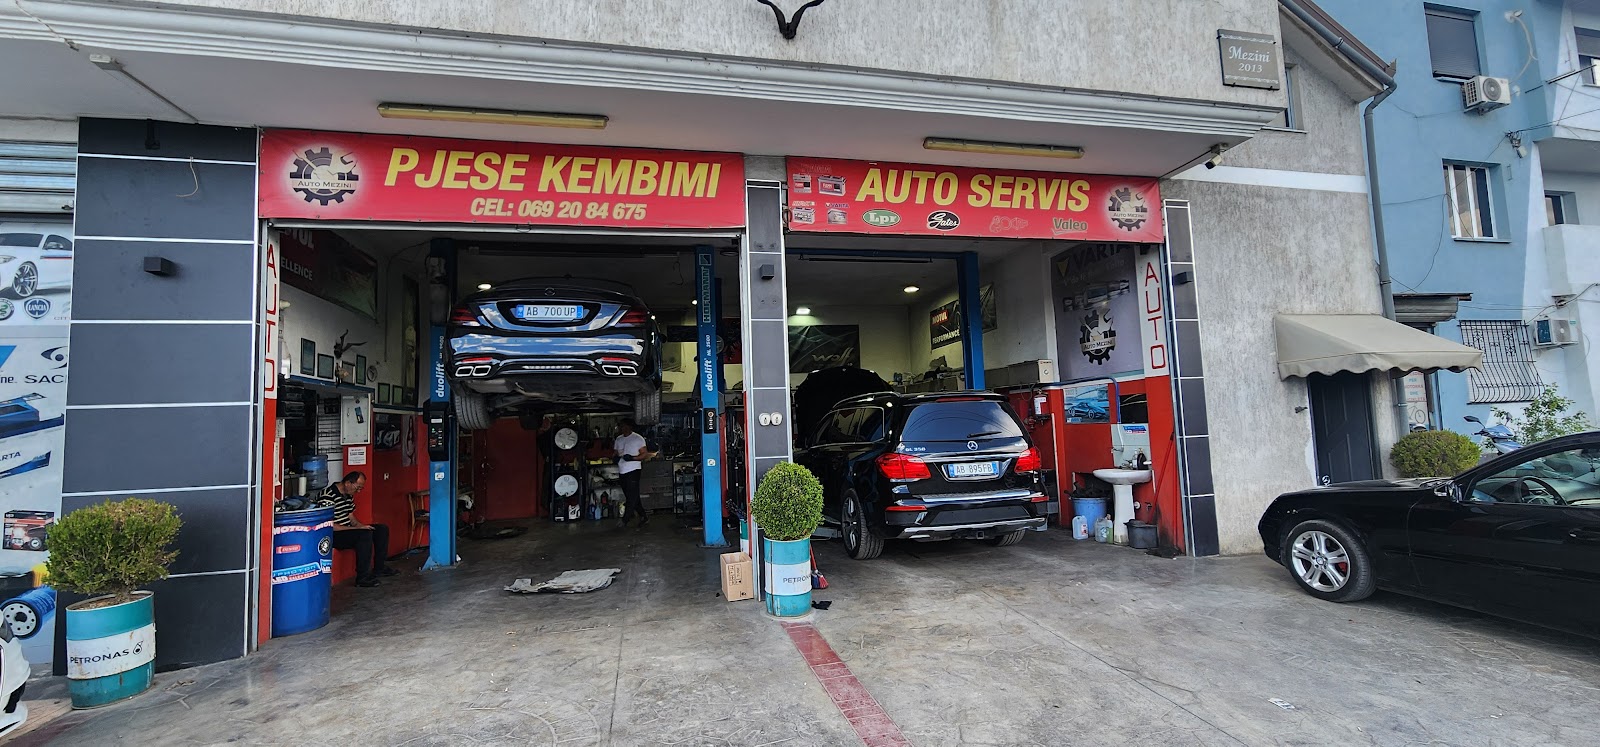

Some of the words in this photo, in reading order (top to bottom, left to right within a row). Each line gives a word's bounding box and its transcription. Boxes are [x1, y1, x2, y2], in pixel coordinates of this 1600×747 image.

[1228, 46, 1270, 63] Mezini
[1238, 63, 1263, 73] 2013
[384, 147, 530, 191] PJESE
[537, 155, 722, 198] KEMBIMI
[322, 181, 352, 189] MEZINI
[855, 168, 959, 206] AUTO
[967, 174, 1091, 213] SERVIS
[470, 197, 514, 217] CEL:
[518, 199, 555, 218] 069
[557, 201, 582, 219] 20
[585, 202, 609, 220] 84
[612, 203, 648, 221] 675
[868, 212, 897, 225] Lpr
[927, 211, 958, 228] Gates
[1054, 218, 1088, 231] Valeo
[28, 303, 47, 312] LANCIA
[526, 306, 539, 316] AB
[1145, 262, 1167, 370] AUTO
[24, 374, 68, 384] SAC
[435, 361, 445, 398] duolift
[704, 359, 714, 392] duolift
[956, 465, 966, 474] AB
[69, 648, 130, 664] PETRONAS
